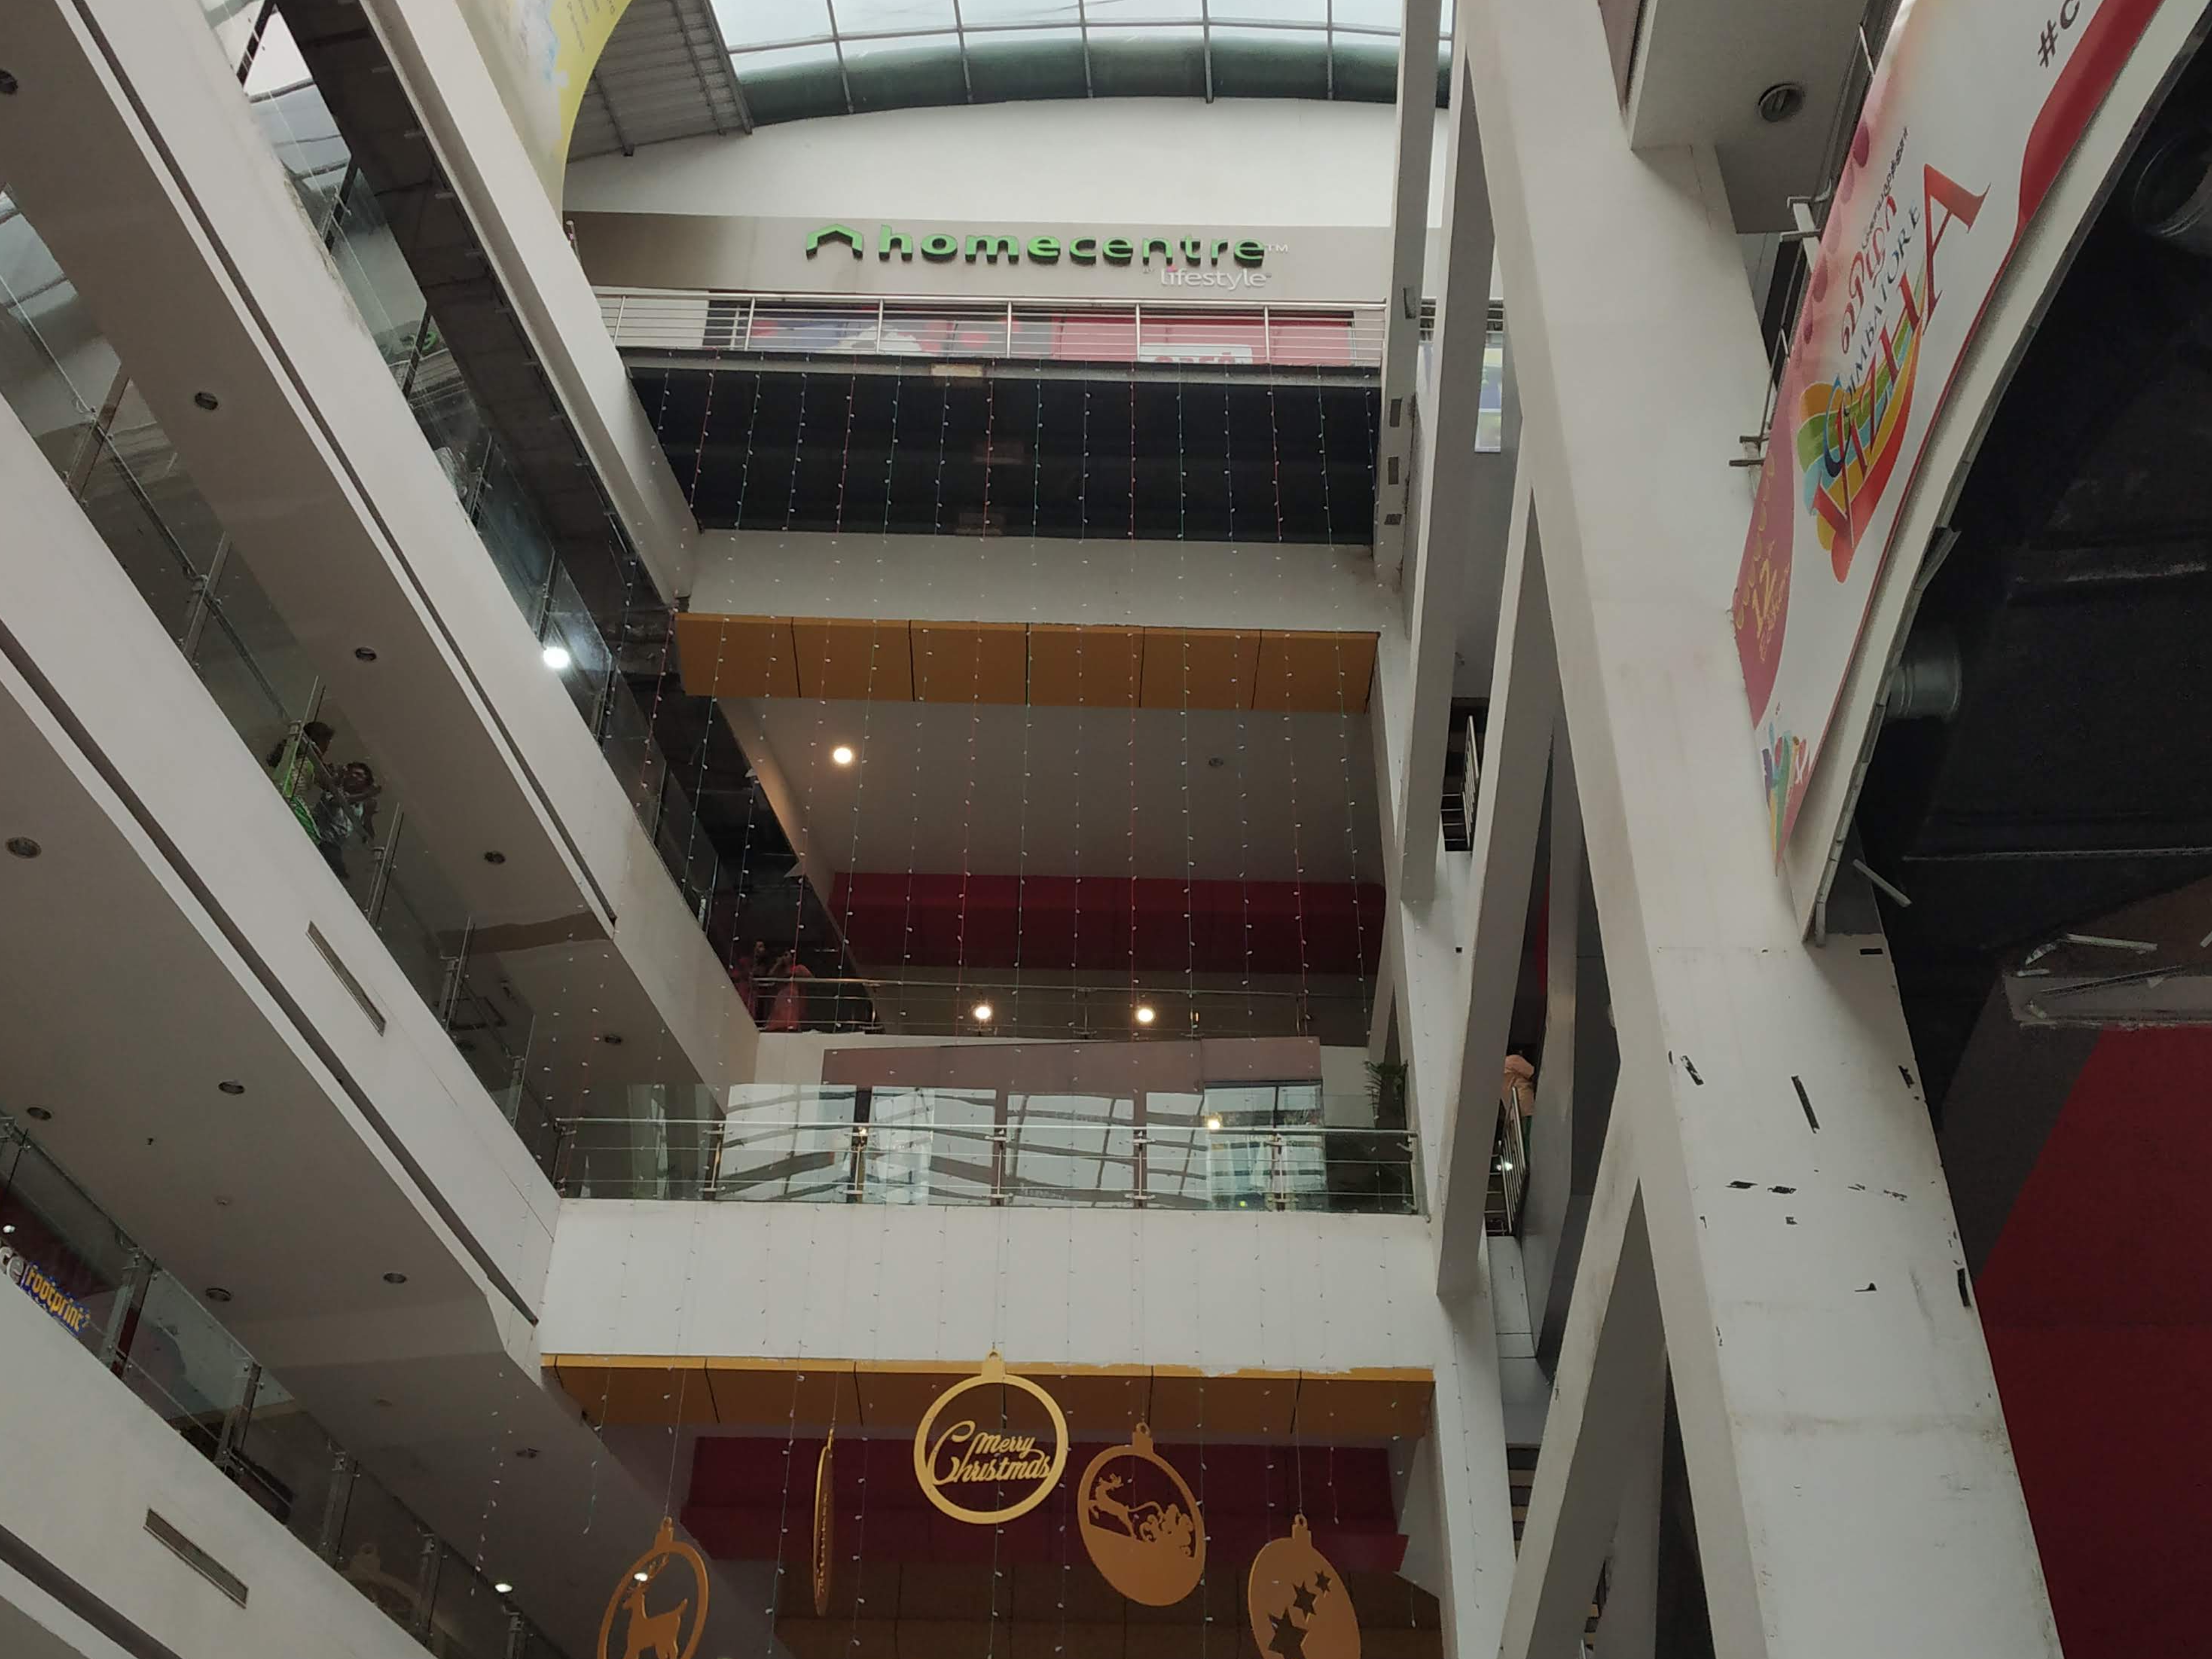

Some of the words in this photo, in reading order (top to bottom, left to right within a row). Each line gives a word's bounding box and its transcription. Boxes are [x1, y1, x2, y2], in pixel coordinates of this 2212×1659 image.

[878, 224, 1265, 267] homecentre
[1161, 265, 1267, 290] lifestyle
[1812, 164, 1991, 549] VIZHA
[1824, 201, 1921, 478] COIMBATORE
[927, 1420, 1051, 1485] Christmas
[974, 1432, 1035, 1459] Merry
